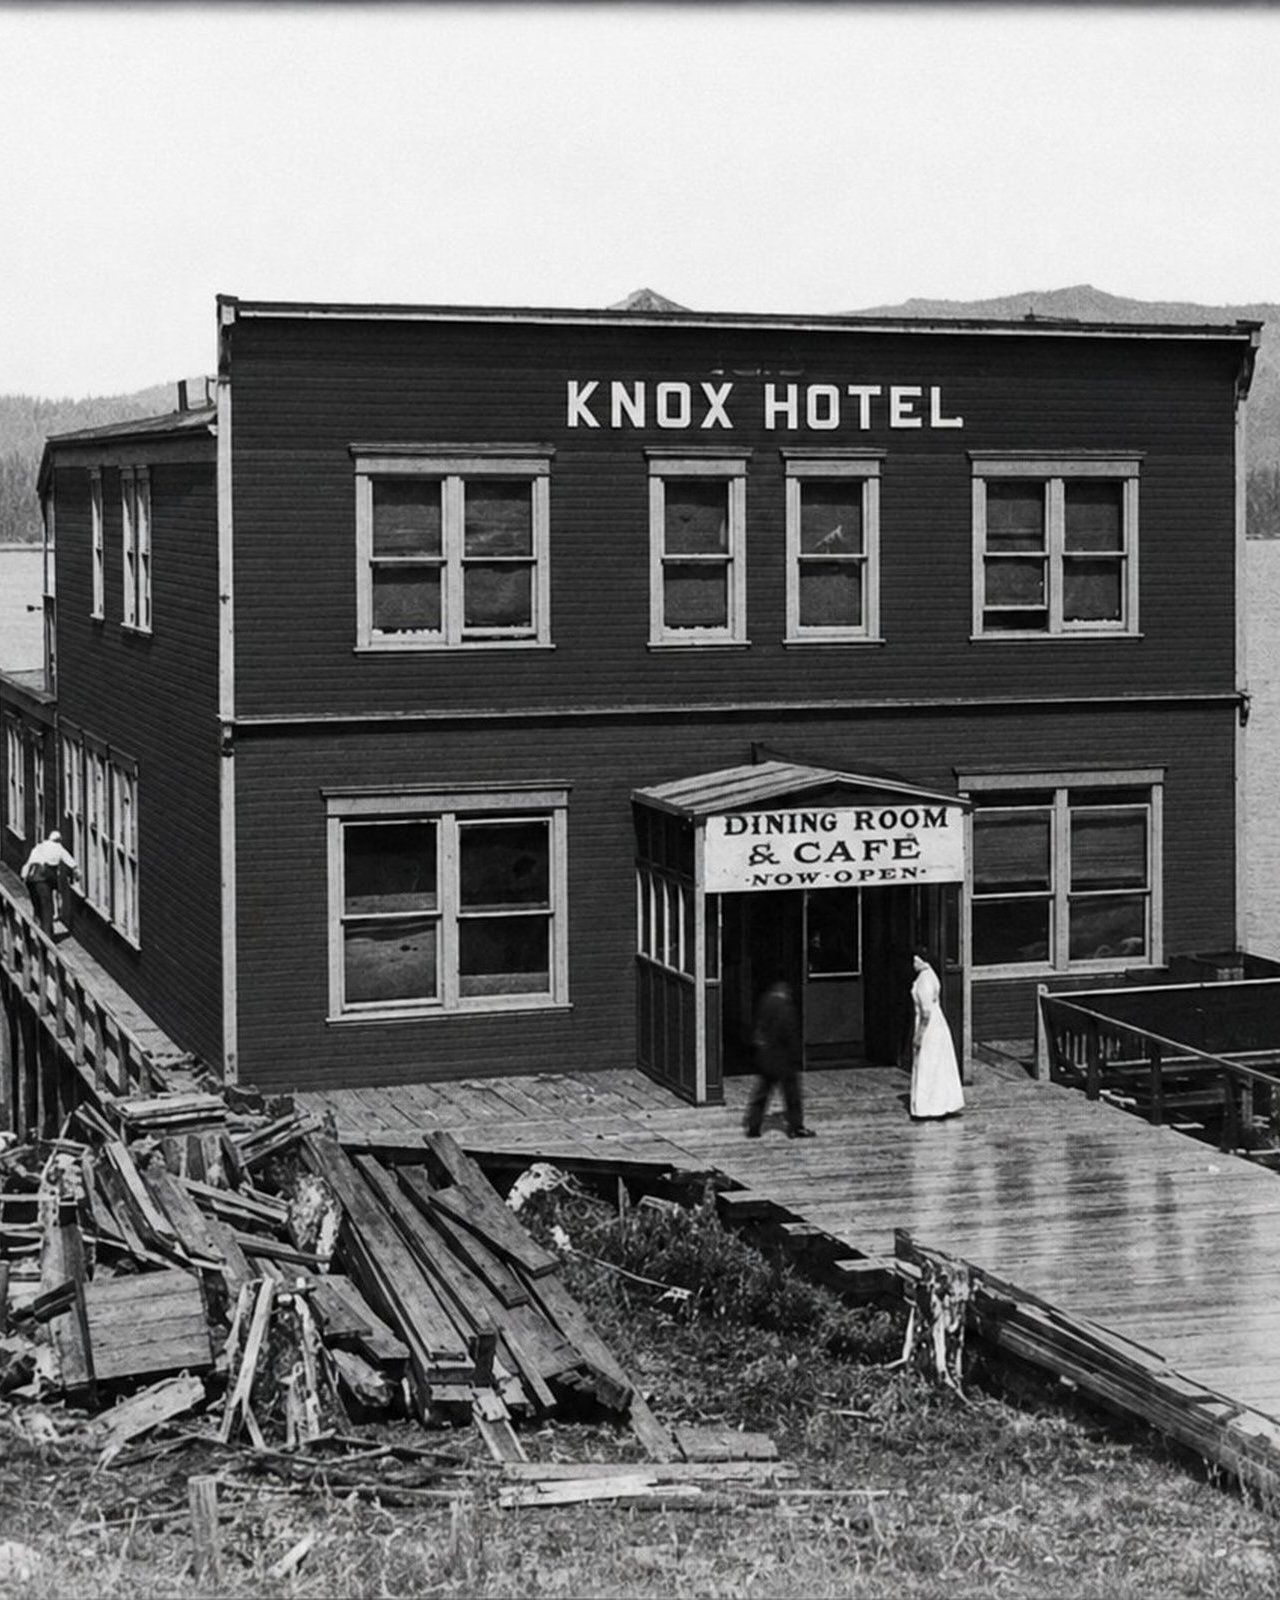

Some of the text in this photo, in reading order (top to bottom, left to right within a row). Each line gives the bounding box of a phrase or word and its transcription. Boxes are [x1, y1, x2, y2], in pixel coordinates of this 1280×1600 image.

[567, 381, 963, 430] KNOX HOTEL
[723, 807, 949, 836] DINING ROOM
[748, 843, 780, 867] &
